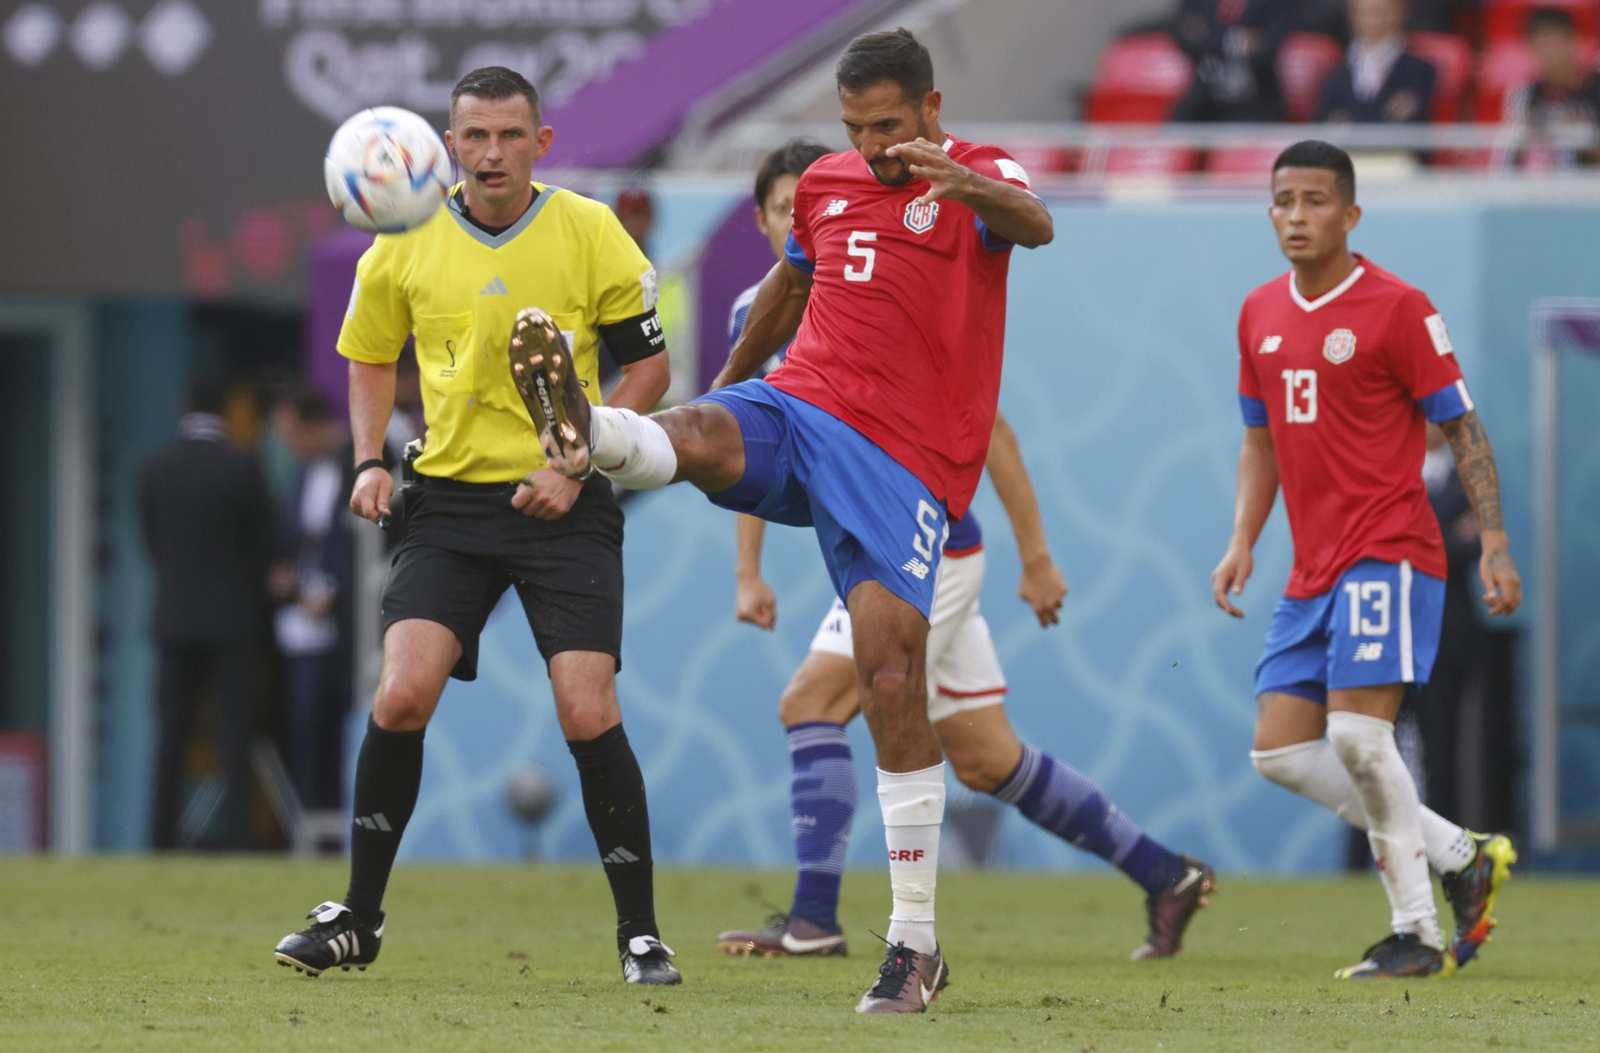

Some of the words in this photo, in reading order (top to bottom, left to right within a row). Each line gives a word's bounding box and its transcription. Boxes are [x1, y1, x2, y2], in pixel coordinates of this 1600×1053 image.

[843, 230, 877, 282] 5
[1281, 368, 1318, 424] 13
[912, 498, 939, 562] 5
[1344, 580, 1391, 637] 13
